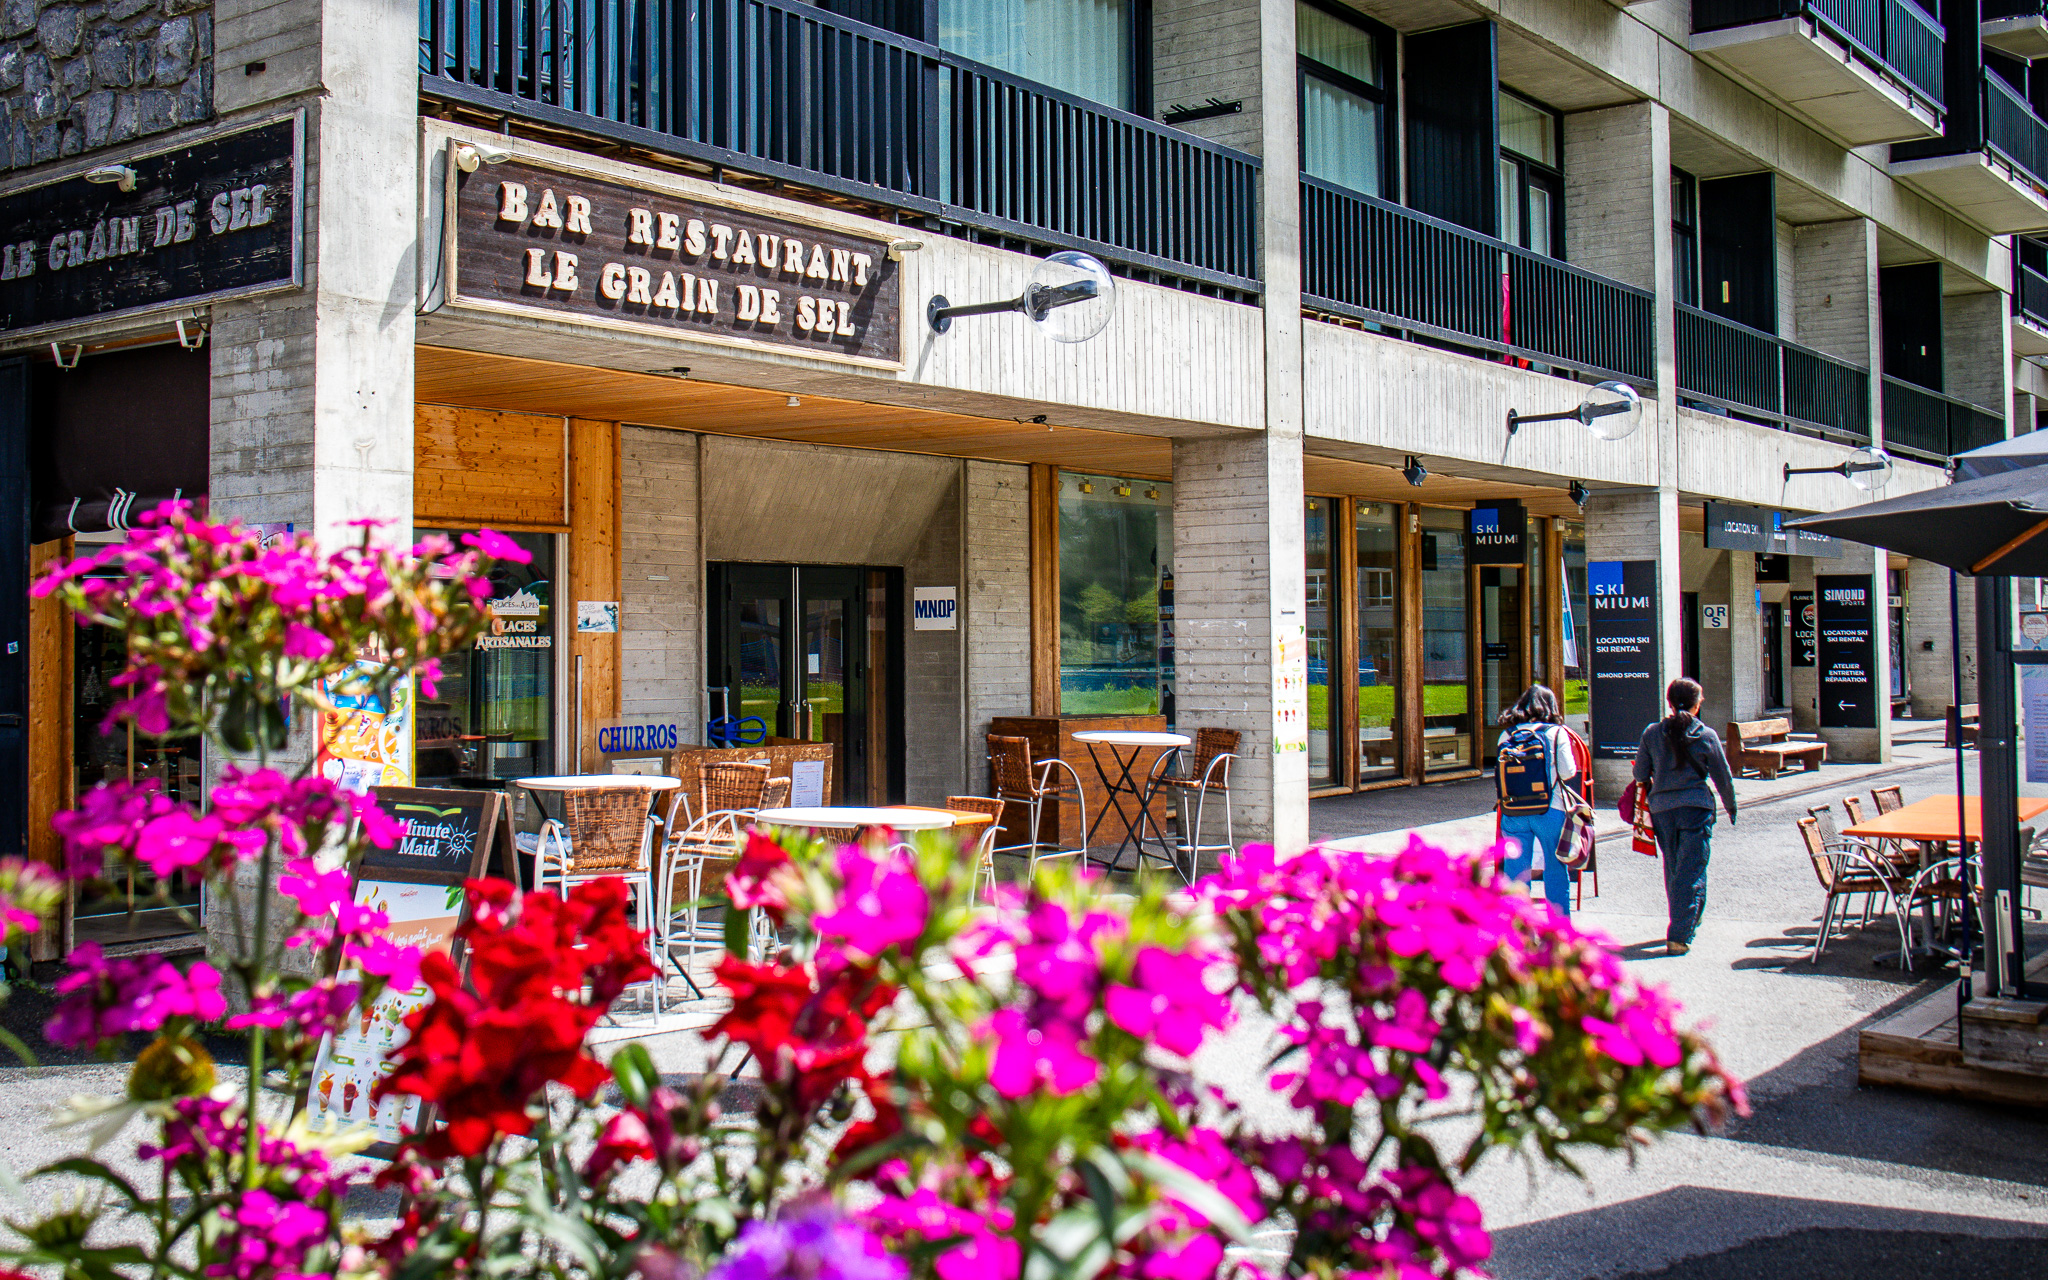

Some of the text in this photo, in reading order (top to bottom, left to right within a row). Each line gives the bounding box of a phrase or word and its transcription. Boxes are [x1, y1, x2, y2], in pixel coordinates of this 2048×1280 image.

[1, 184, 273, 280] LE GRAIN DE SEL
[500, 181, 872, 287] BAR RESTAURANT
[525, 247, 855, 337] LE GRAIN DE SEL
[1476, 524, 1500, 534] SKI
[1724, 521, 1751, 534] LOCATION
[1595, 583, 1624, 596] SKI
[1824, 589, 1865, 601] SIMOND
[492, 618, 537, 636] GLACES
[1711, 617, 1721, 627] S
[475, 636, 552, 651] ARTISANALES
[1610, 645, 1641, 653] RENTAL
[598, 724, 678, 753] CHURROS
[398, 817, 451, 839] Minute
[397, 836, 440, 857] Maid
